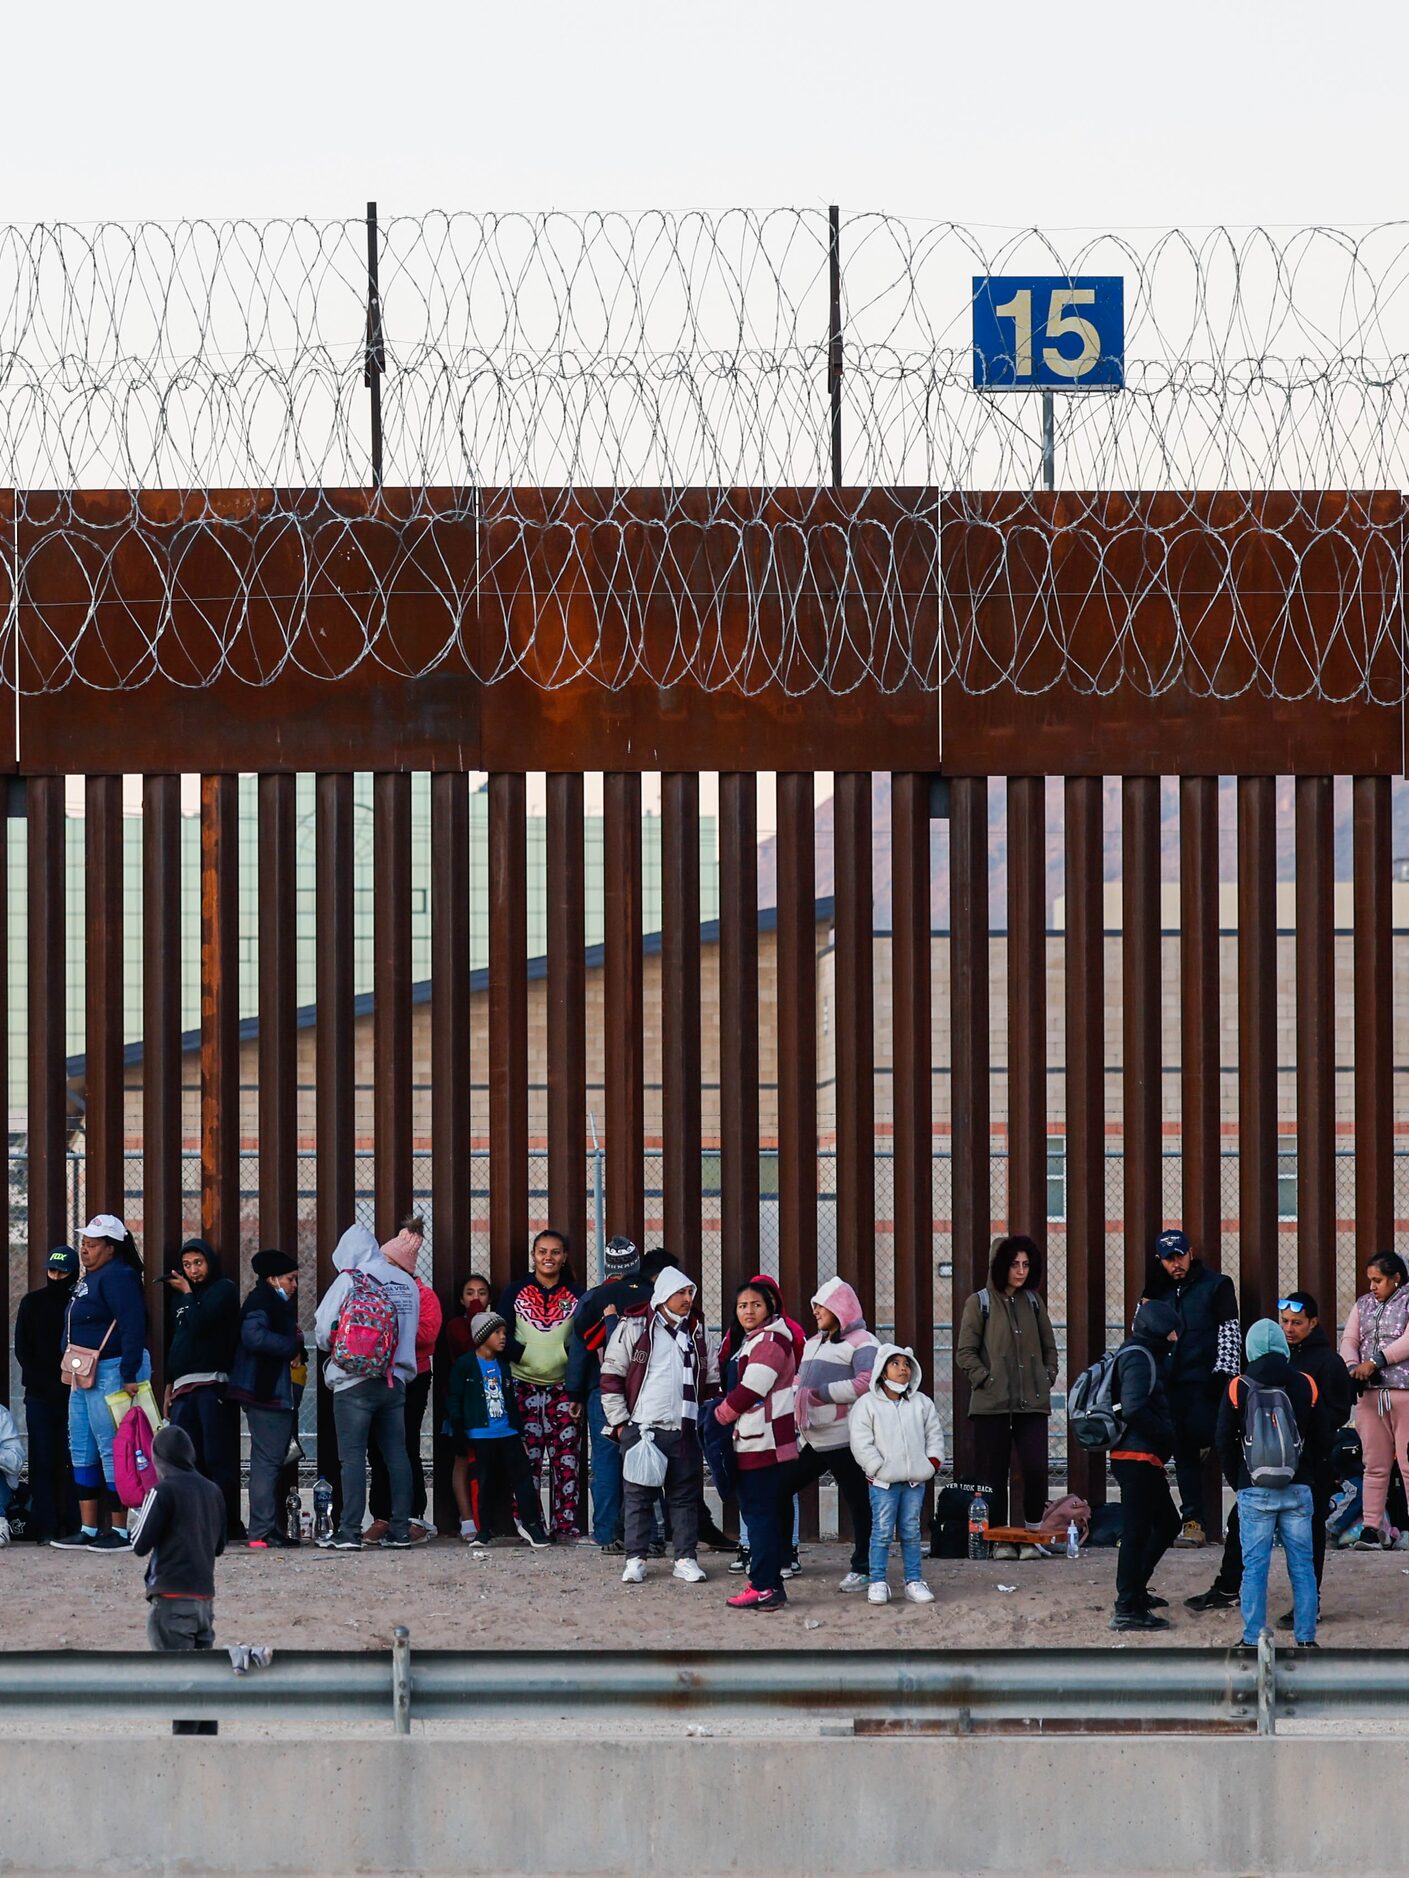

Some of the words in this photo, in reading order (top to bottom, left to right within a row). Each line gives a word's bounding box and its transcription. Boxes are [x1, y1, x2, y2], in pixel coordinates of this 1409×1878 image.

[995, 288, 1101, 378] 15
[49, 1253, 67, 1261] FOX
[960, 1483, 975, 1492] LOOK
[977, 1485, 993, 1493] BACK
